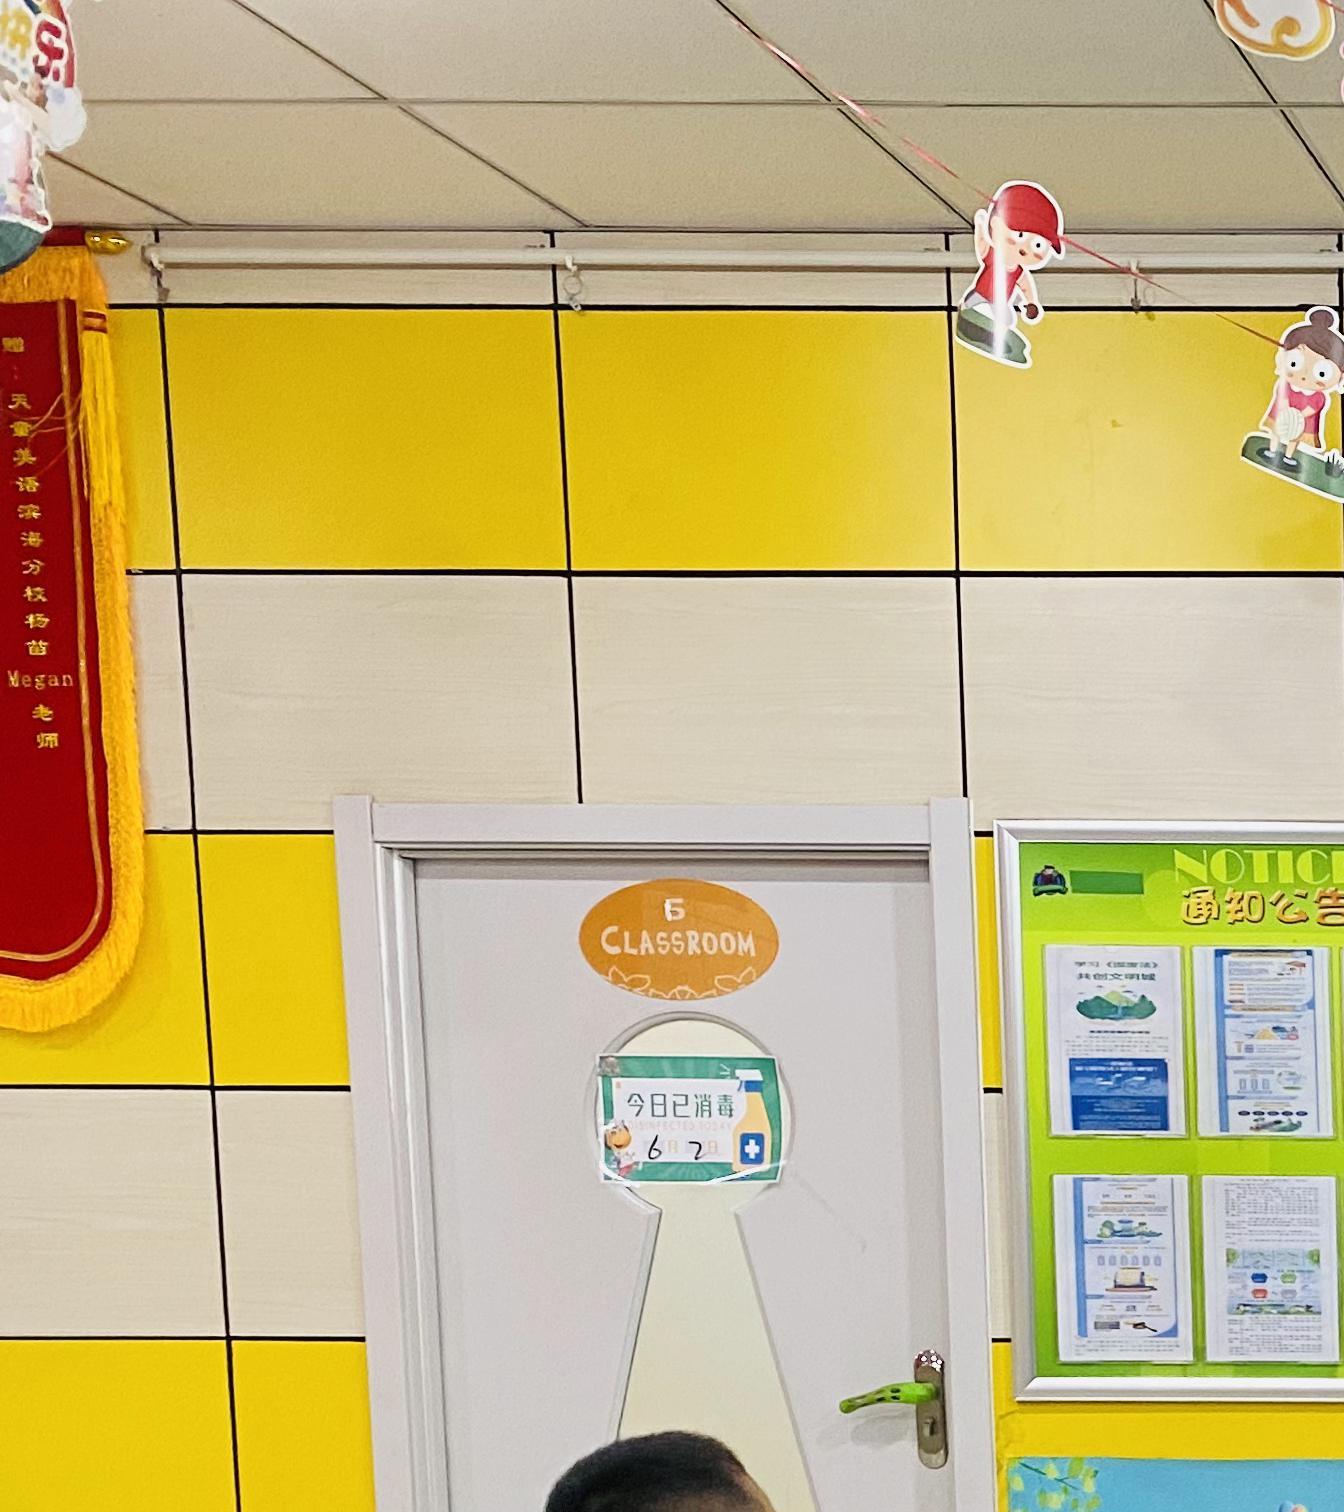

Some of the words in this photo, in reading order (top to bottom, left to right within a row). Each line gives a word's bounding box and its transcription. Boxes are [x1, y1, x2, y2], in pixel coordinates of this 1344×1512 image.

[7, 670, 73, 690] Megan
[600, 925, 756, 957] CLASSROOM
[627, 1092, 734, 1119] 今日已消毒
[648, 1134, 662, 1160] 6
